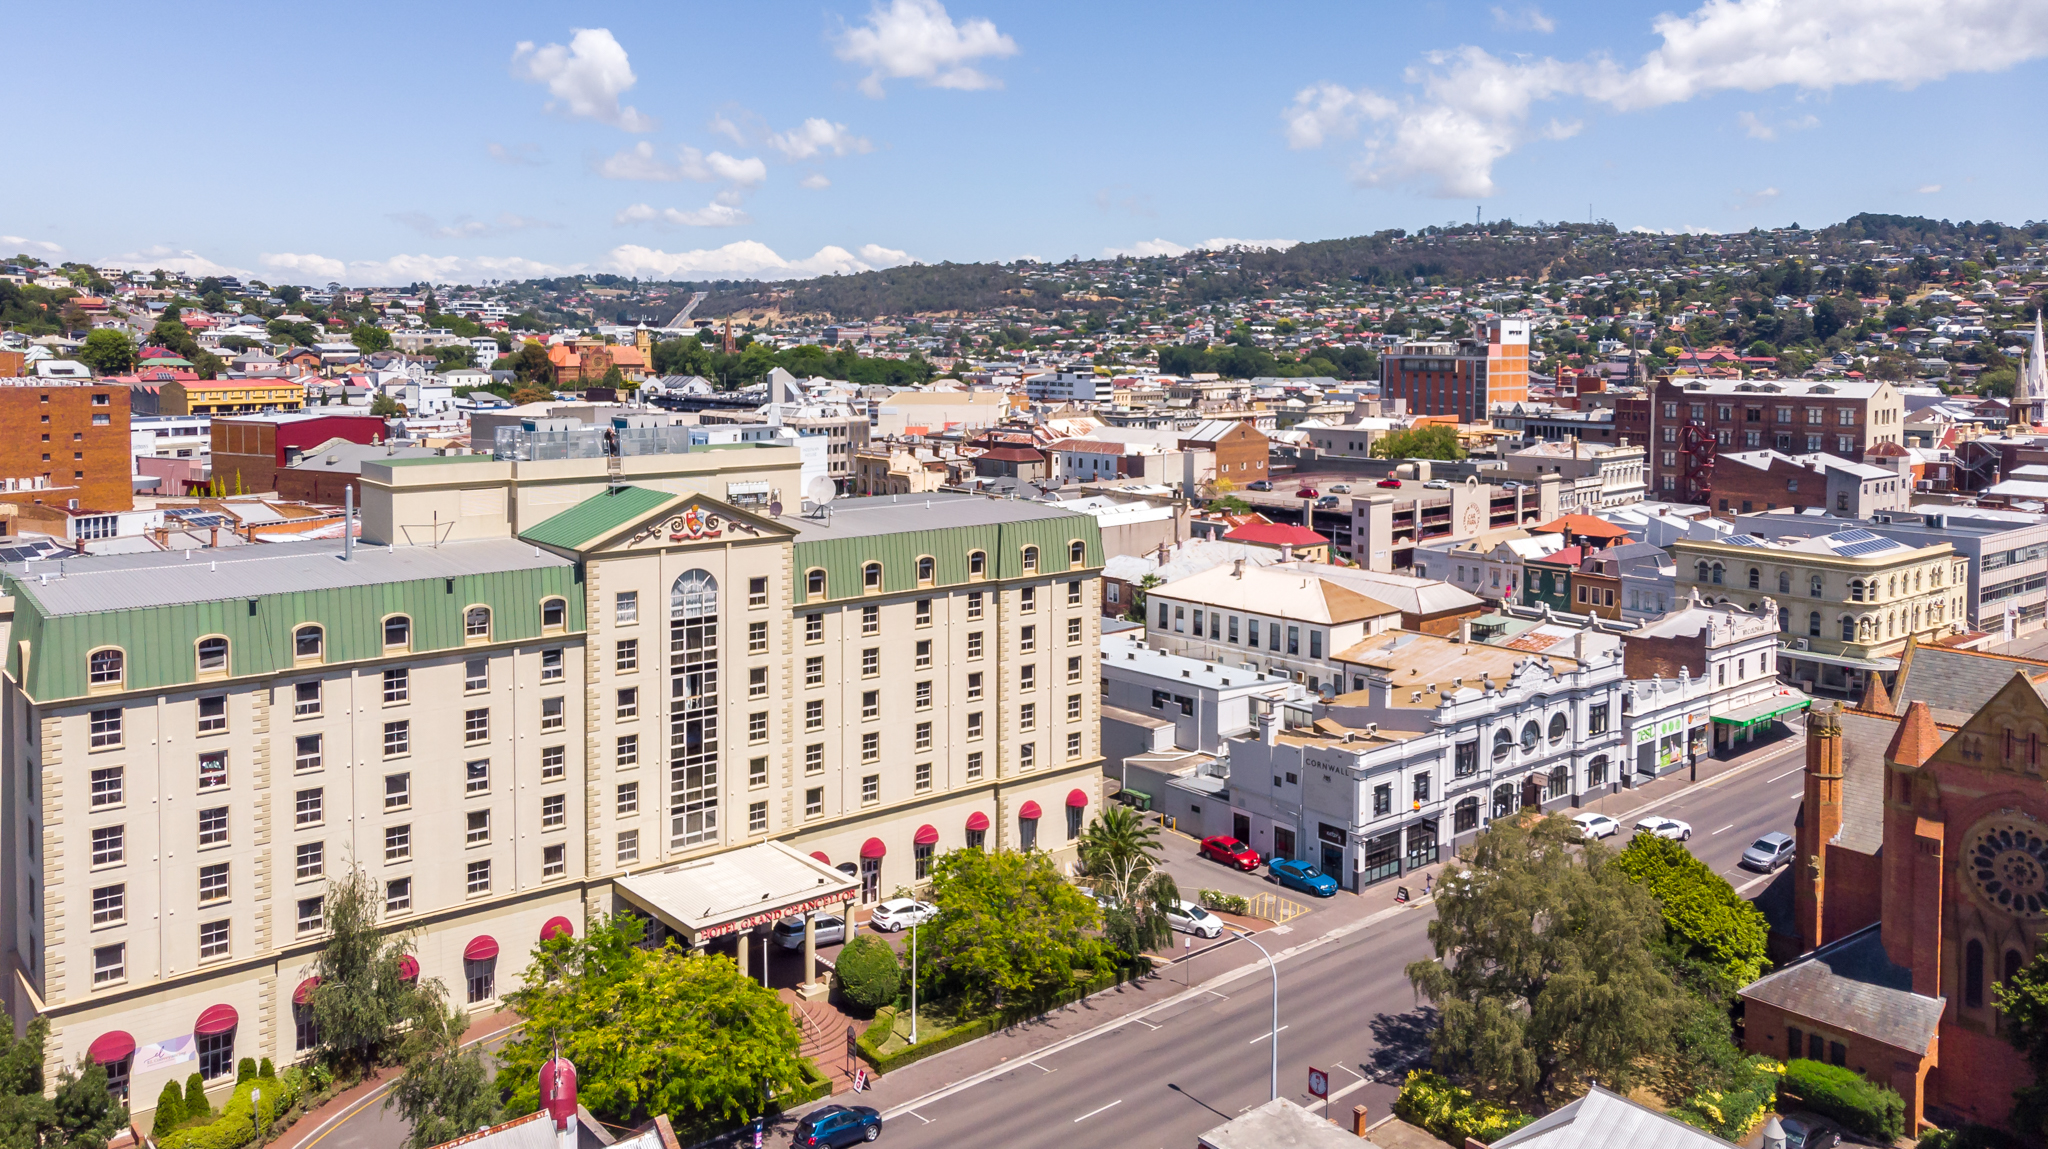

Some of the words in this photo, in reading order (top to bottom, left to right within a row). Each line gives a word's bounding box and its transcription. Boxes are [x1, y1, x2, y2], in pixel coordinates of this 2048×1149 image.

[1305, 758, 1349, 776] CORNWALL
[701, 921, 738, 940] HOTEL
[741, 909, 782, 929] GRAND
[784, 889, 856, 917] CHANCELLOR
